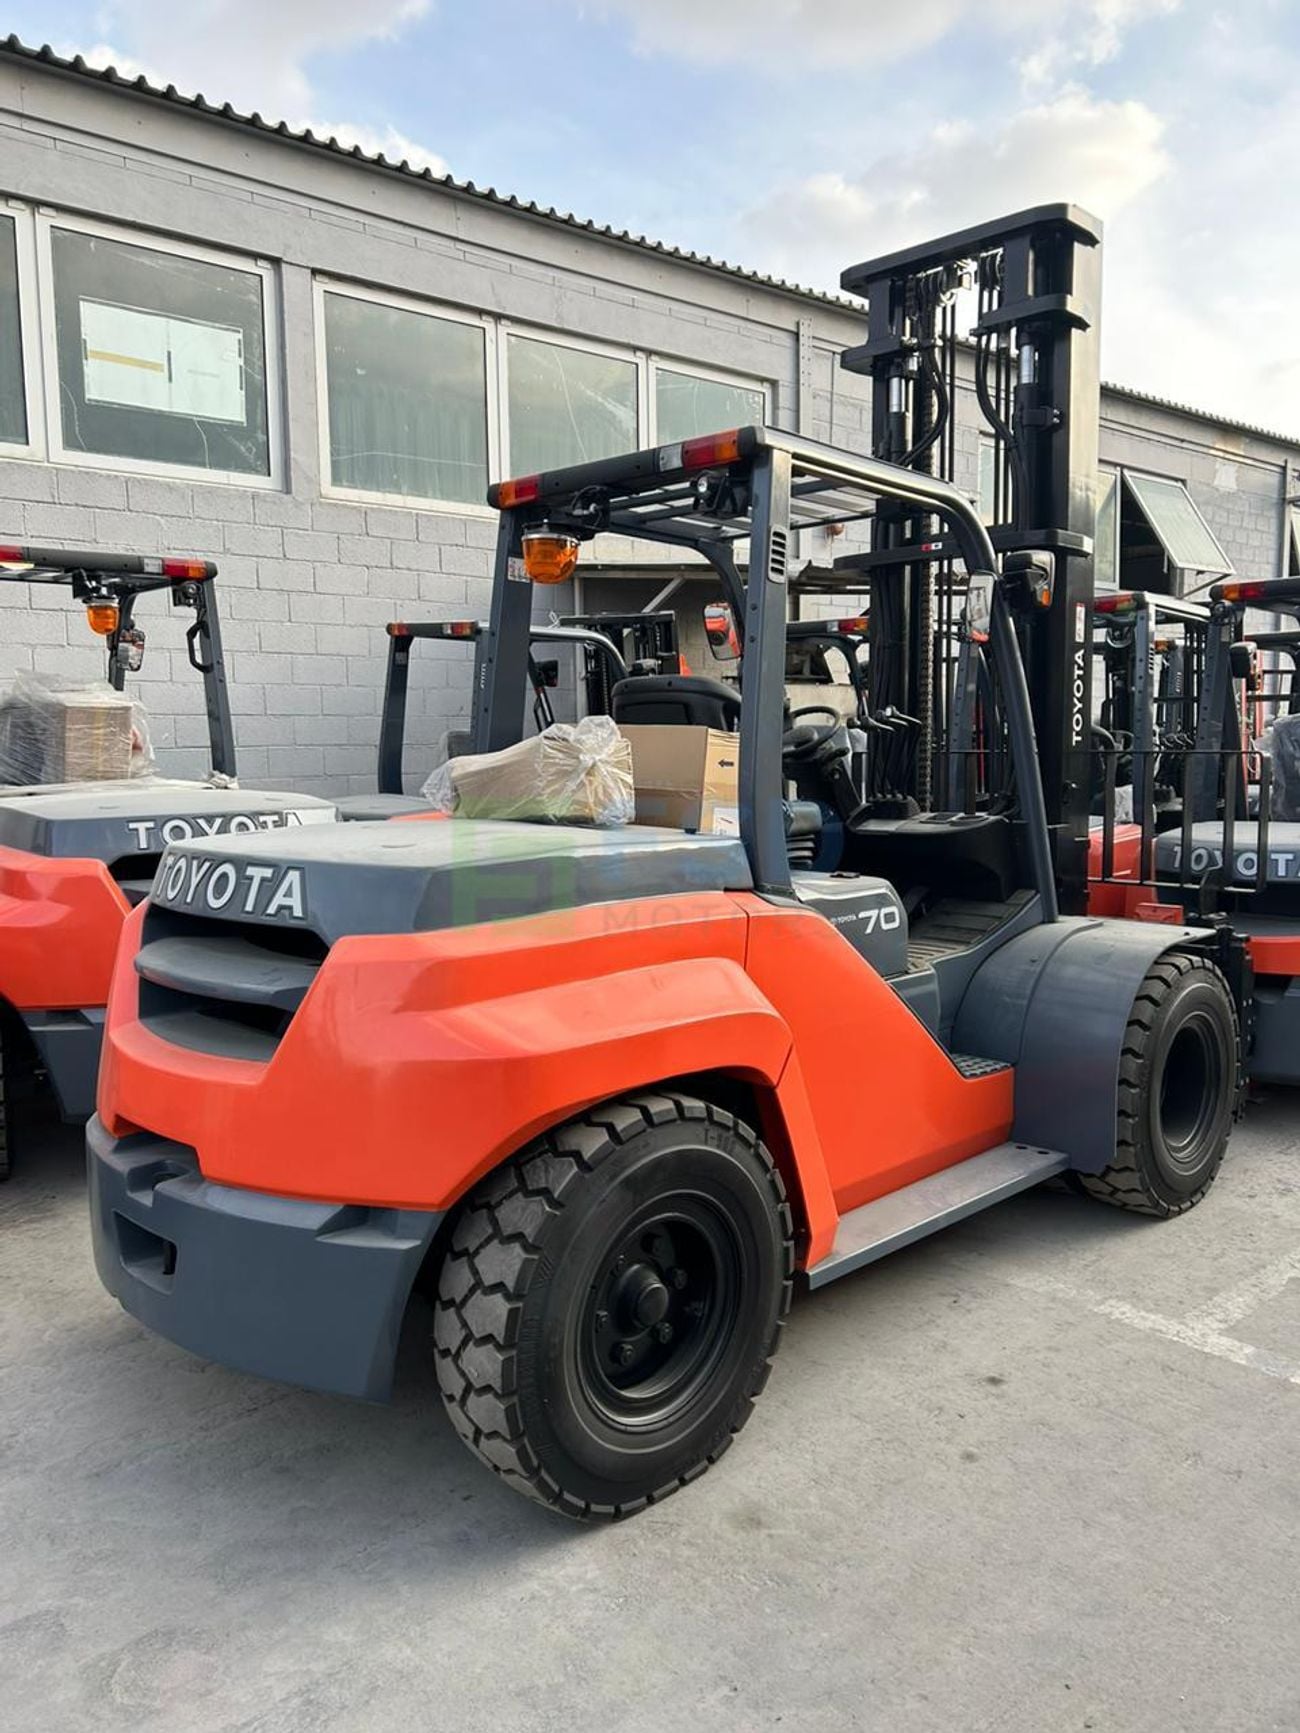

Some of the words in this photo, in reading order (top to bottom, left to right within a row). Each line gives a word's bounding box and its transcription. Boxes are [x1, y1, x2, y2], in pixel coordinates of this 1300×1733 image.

[1073, 649, 1084, 746] TOYOTA
[157, 854, 304, 918] TOYOTA
[858, 906, 900, 934] 70
